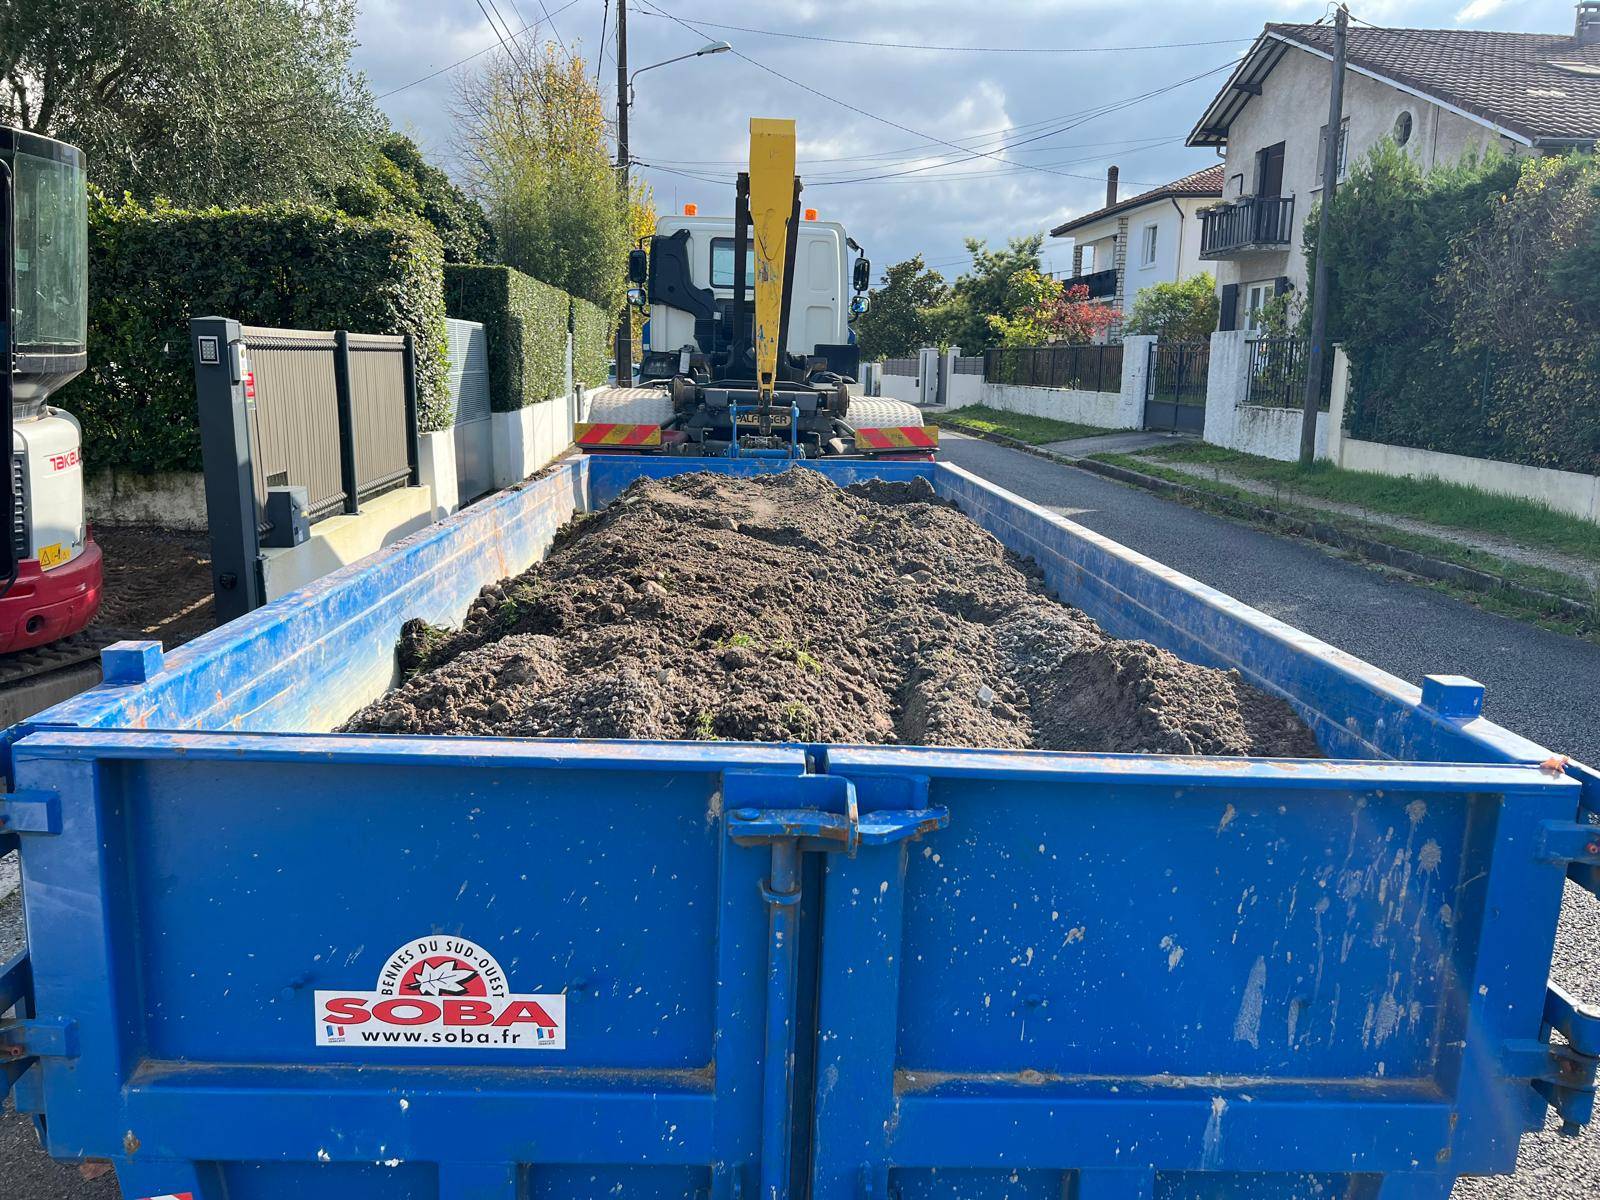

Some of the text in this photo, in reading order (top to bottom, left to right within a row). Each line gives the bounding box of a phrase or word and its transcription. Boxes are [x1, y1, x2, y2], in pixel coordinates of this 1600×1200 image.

[381, 940, 505, 998] BENNES DU SUD-OUEST
[322, 997, 559, 1028] SOBA
[361, 1029, 521, 1044] www.soba.fr
